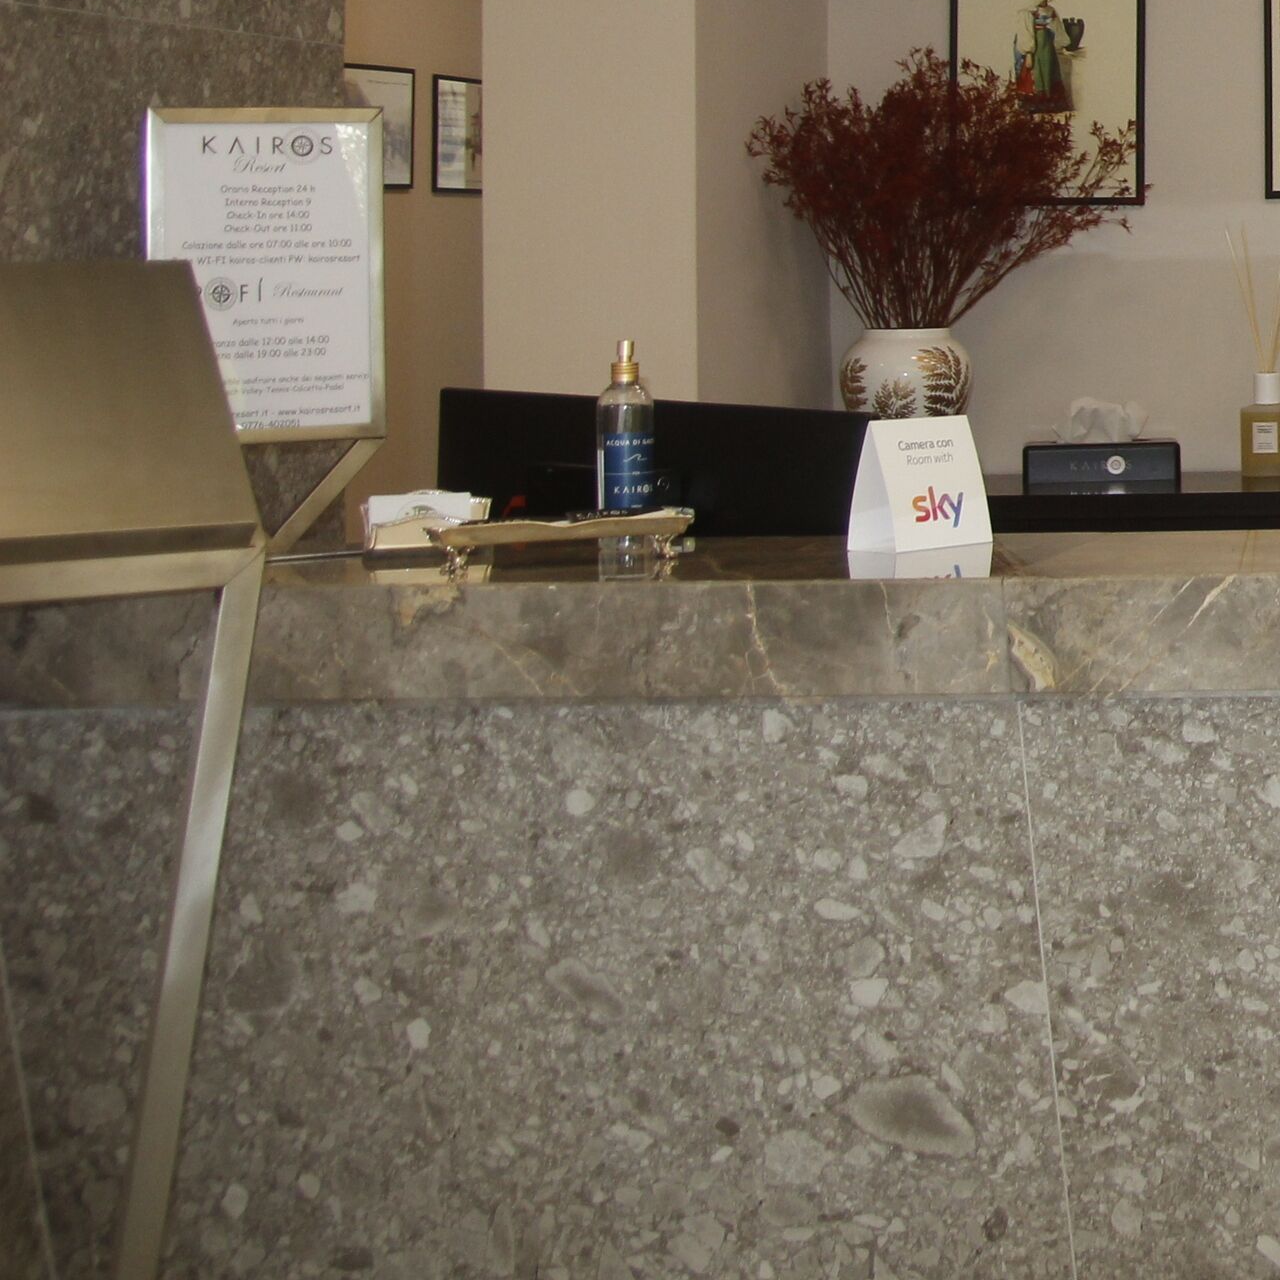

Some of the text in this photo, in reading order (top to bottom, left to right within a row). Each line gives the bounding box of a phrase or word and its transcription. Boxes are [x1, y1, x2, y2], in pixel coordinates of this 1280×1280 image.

[202, 135, 333, 157] KAIROS
[251, 185, 295, 195] Reception
[296, 185, 307, 193] 24
[225, 198, 259, 207] Interno
[261, 198, 303, 208] Reception
[287, 211, 310, 220] 14:00
[290, 223, 312, 232] 11:00
[182, 238, 351, 250] Colazione dalle ore 07:00 alle ore 10:00
[214, 340, 236, 348] anzo
[239, 338, 259, 348] dalle
[262, 336, 286, 346] 12:00
[306, 335, 330, 345] 14:00
[257, 349, 281, 359] 19:00
[606, 439, 630, 447] ACQUA
[898, 438, 953, 451] Camera con
[907, 452, 953, 466] Room with
[912, 486, 963, 528] sky
